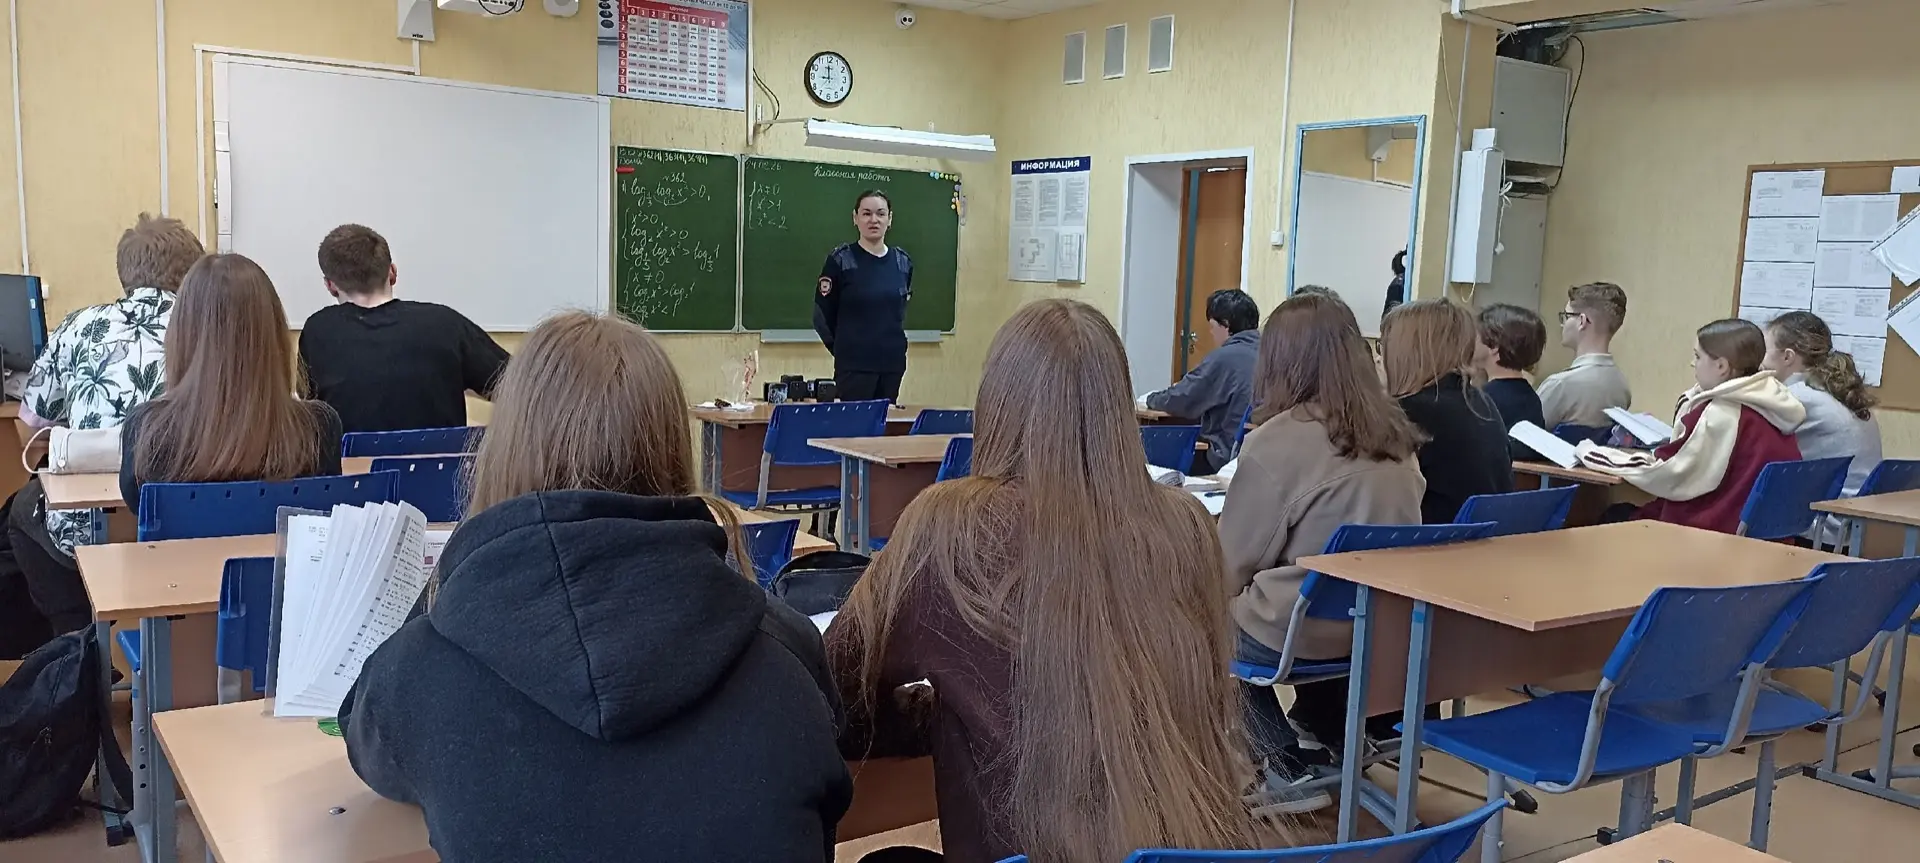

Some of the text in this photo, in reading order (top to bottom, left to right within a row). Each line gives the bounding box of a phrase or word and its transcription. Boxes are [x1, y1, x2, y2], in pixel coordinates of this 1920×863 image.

[1020, 160, 1080, 170] ИНФОРМАЦИЯ
[813, 164, 891, 183] Классная работа
